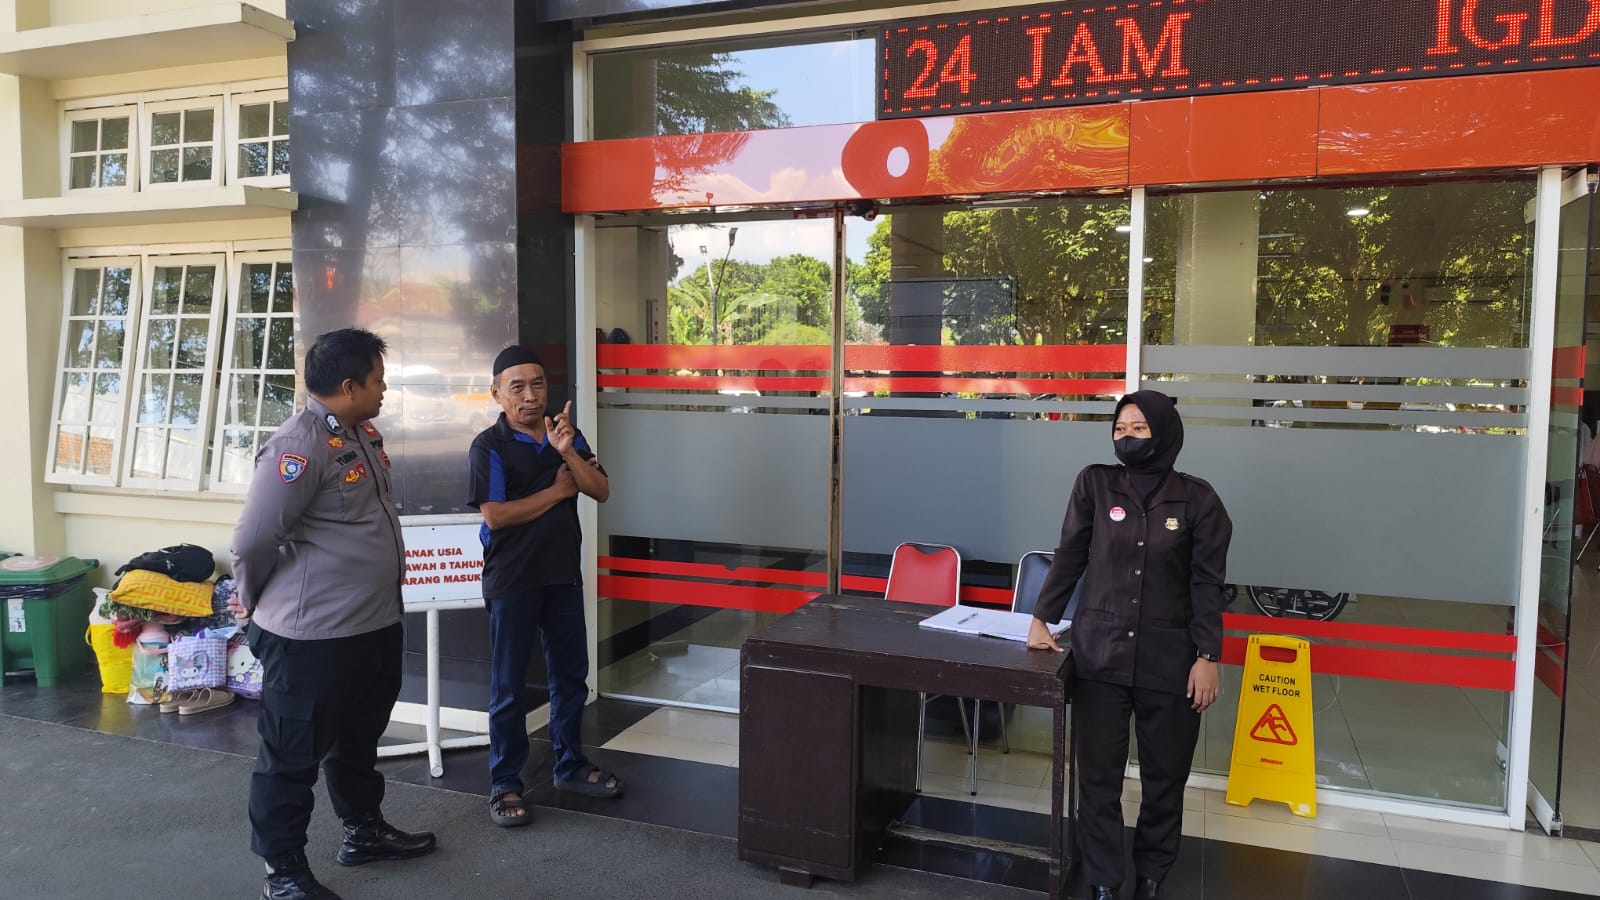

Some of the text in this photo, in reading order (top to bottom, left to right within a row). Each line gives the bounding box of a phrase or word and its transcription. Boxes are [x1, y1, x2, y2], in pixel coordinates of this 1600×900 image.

[903, 0, 1600, 98] 24 JAM IGD
[404, 547, 463, 558] ANAK USIA
[405, 560, 484, 571] AWAH 8 TAHUN
[402, 574, 481, 585] ARANG MASUK
[1258, 673, 1296, 686] CAUTION
[1252, 684, 1300, 697] WET FLOOR
